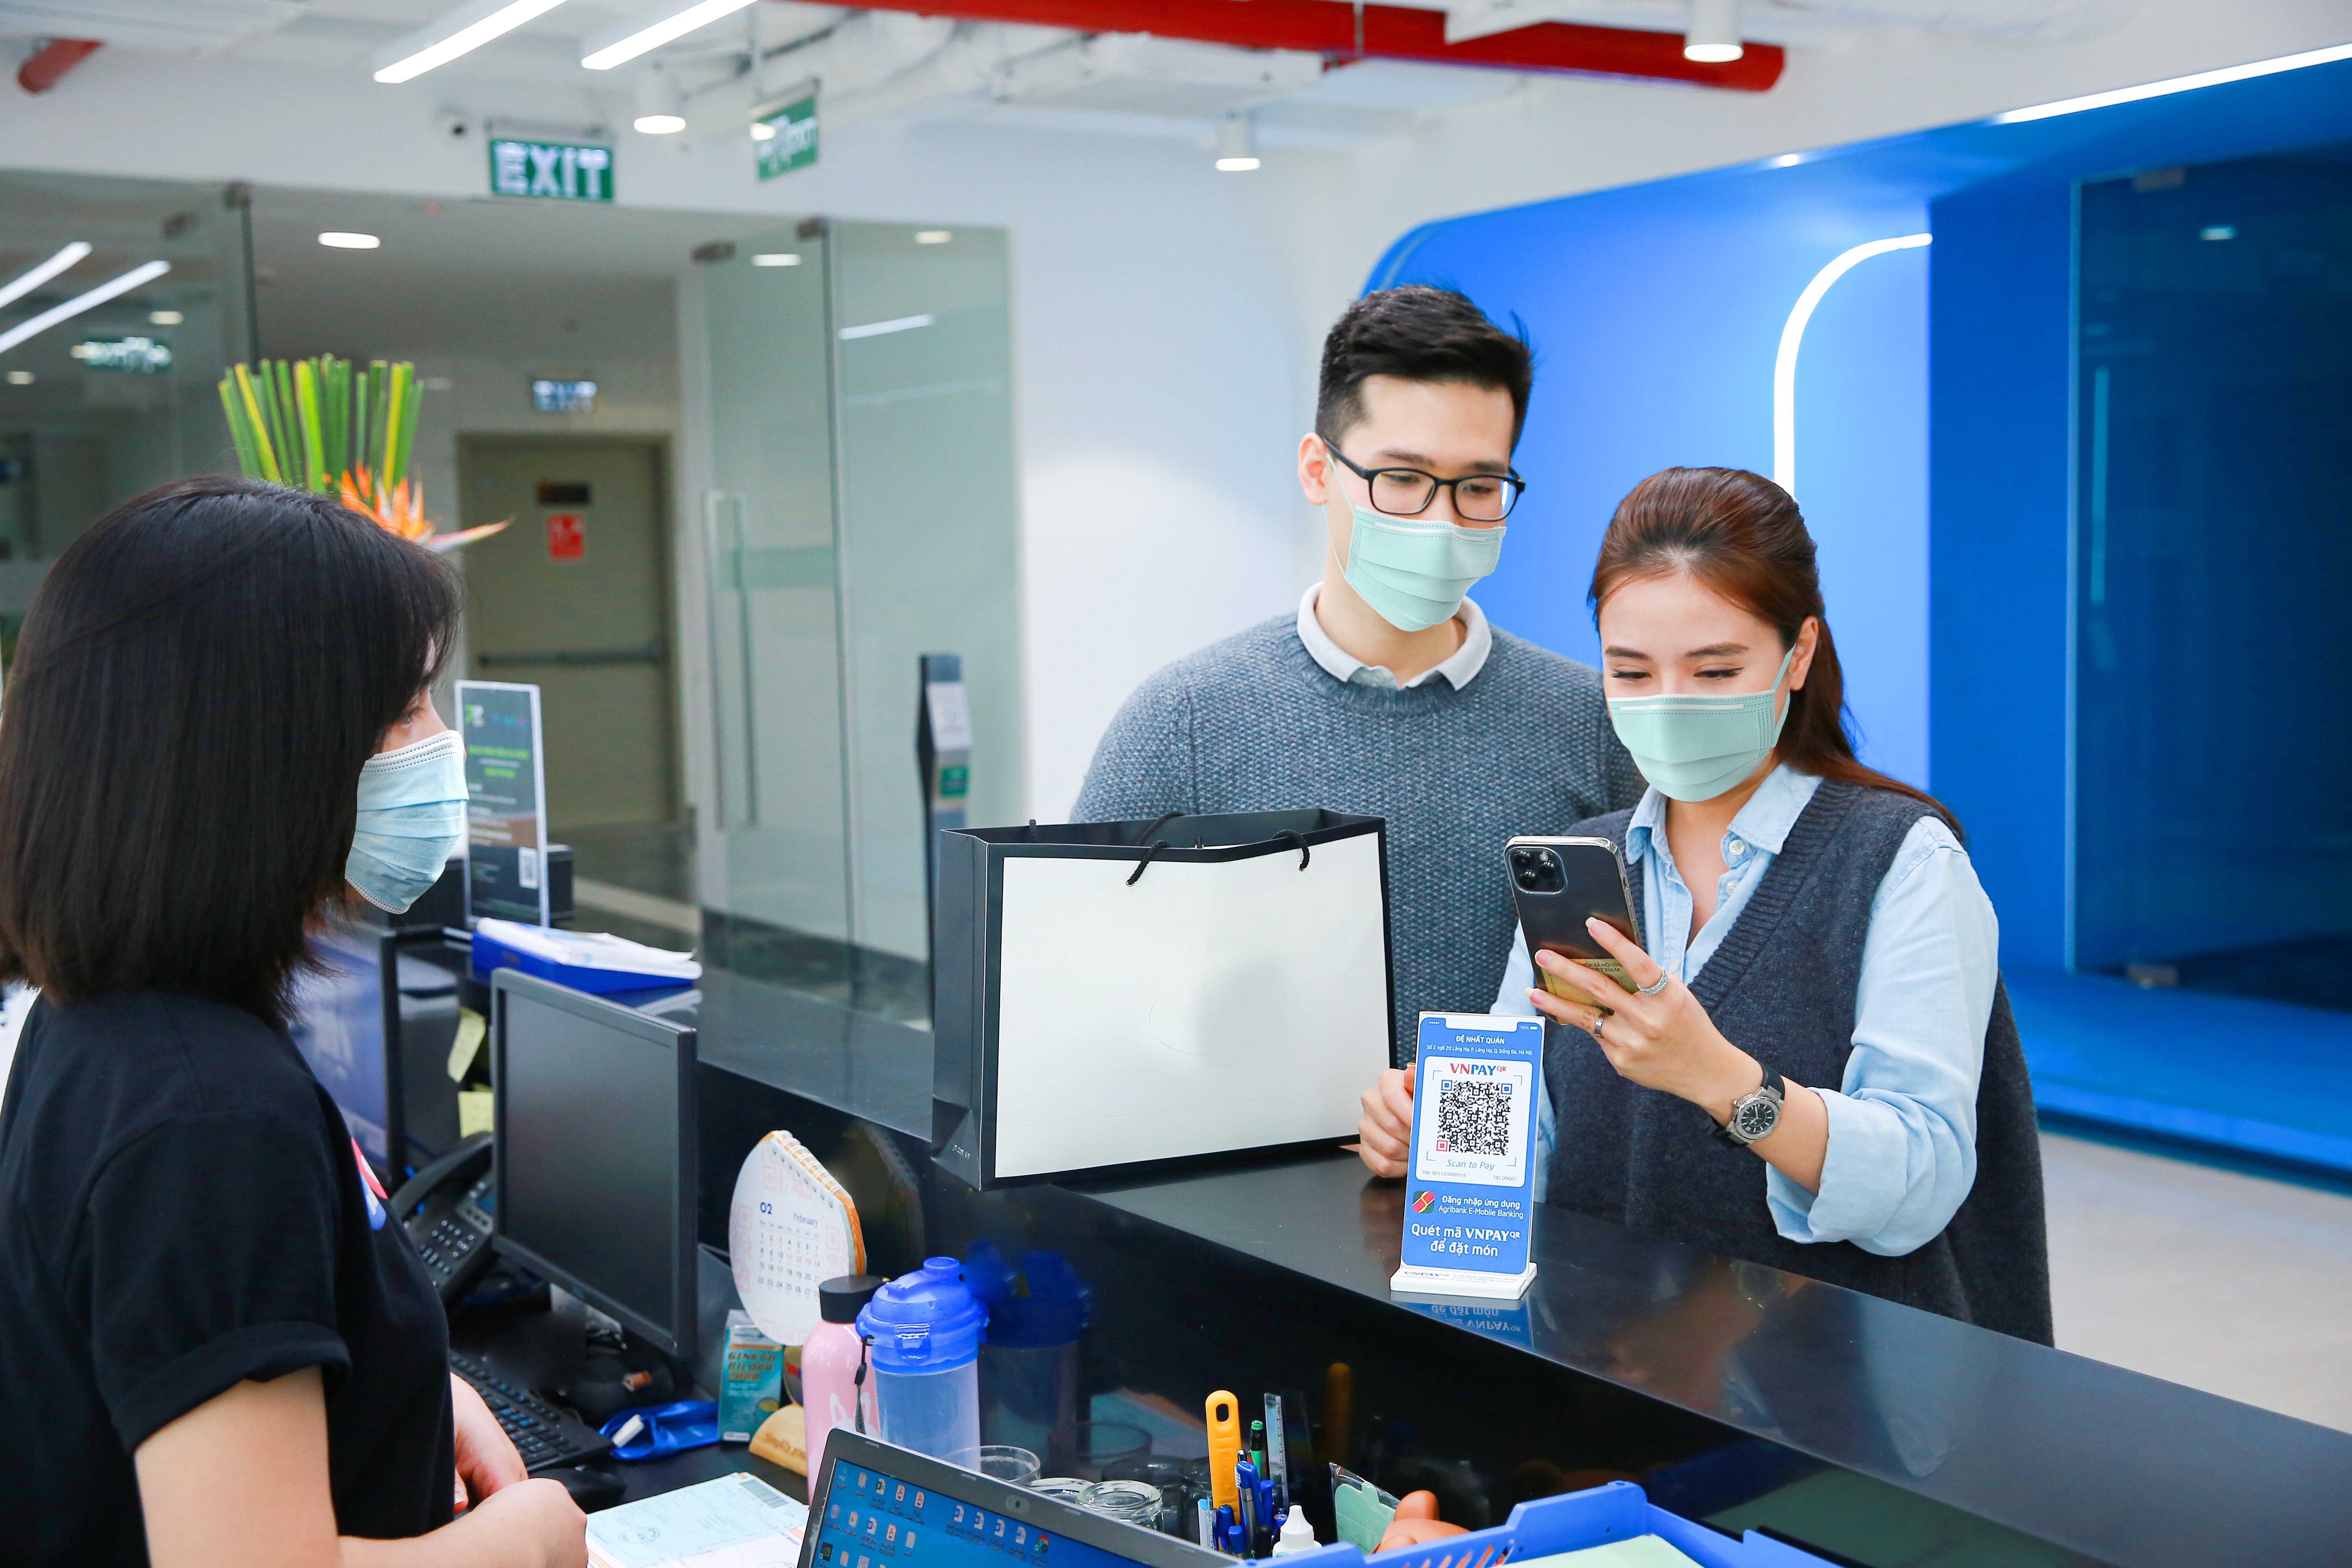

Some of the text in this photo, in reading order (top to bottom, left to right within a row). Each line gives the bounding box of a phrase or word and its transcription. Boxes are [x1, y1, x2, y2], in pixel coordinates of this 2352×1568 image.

[493, 141, 609, 200] EXIT
[1455, 1034, 1505, 1045] ĐỆ NHẤT QUÁN
[1446, 1159, 1495, 1171] Scan to Pay
[760, 1202, 772, 1214] 02
[1441, 1195, 1520, 1210] Đăng nhập ứng dụng
[793, 1212, 818, 1228] February
[1438, 1206, 1524, 1220] Agribank E-Mobile Banking
[1411, 1223, 1441, 1236] Quét
[1443, 1226, 1462, 1238] mã
[1430, 1238, 1498, 1257] để đặt món
